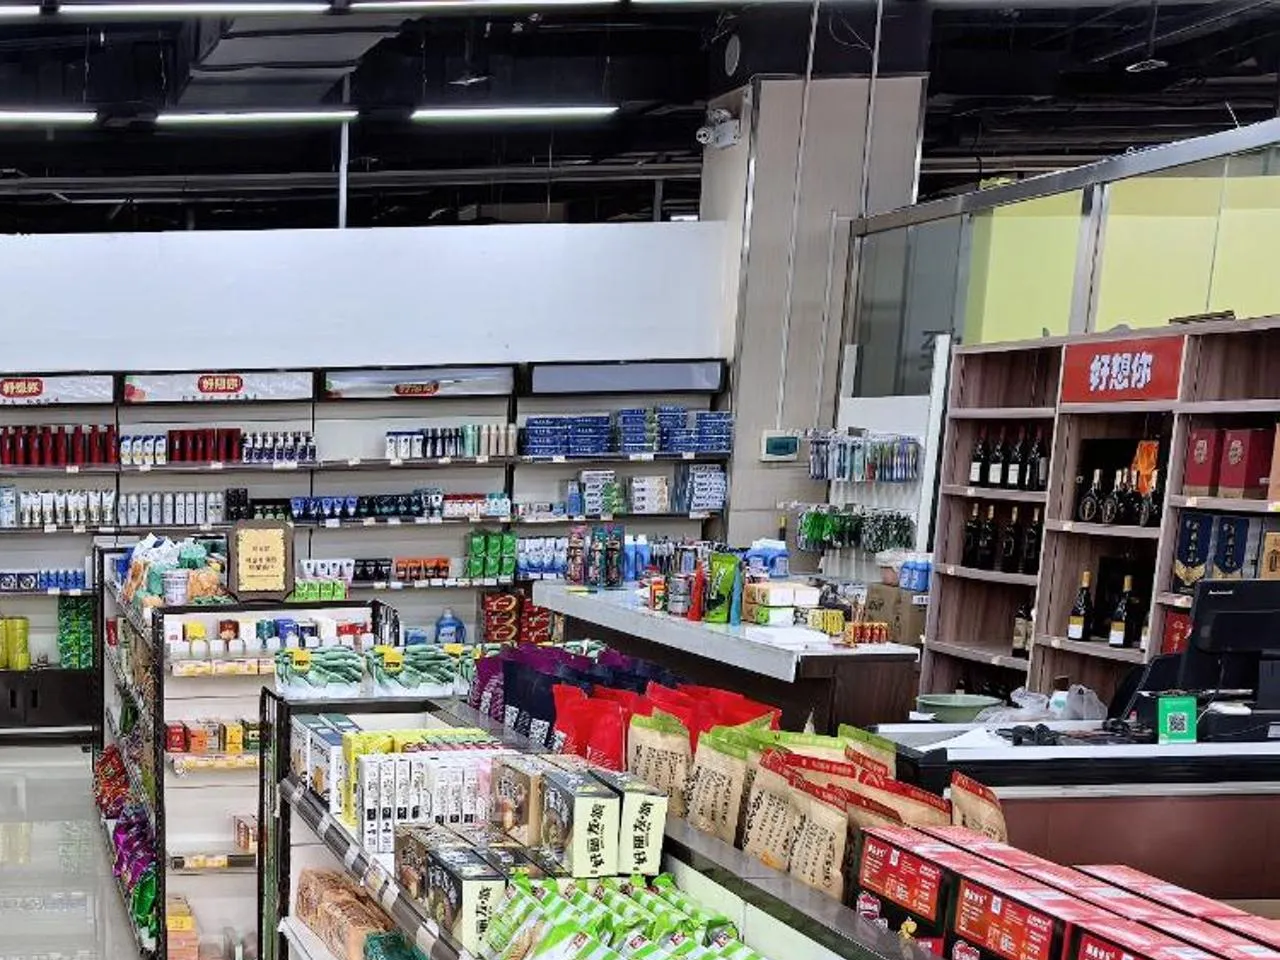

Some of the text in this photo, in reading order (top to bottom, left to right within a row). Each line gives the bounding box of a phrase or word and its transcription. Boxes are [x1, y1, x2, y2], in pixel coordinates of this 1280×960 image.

[1089, 351, 1154, 391] 好想你
[2, 380, 40, 395] 好想你
[202, 377, 239, 391] 好想你
